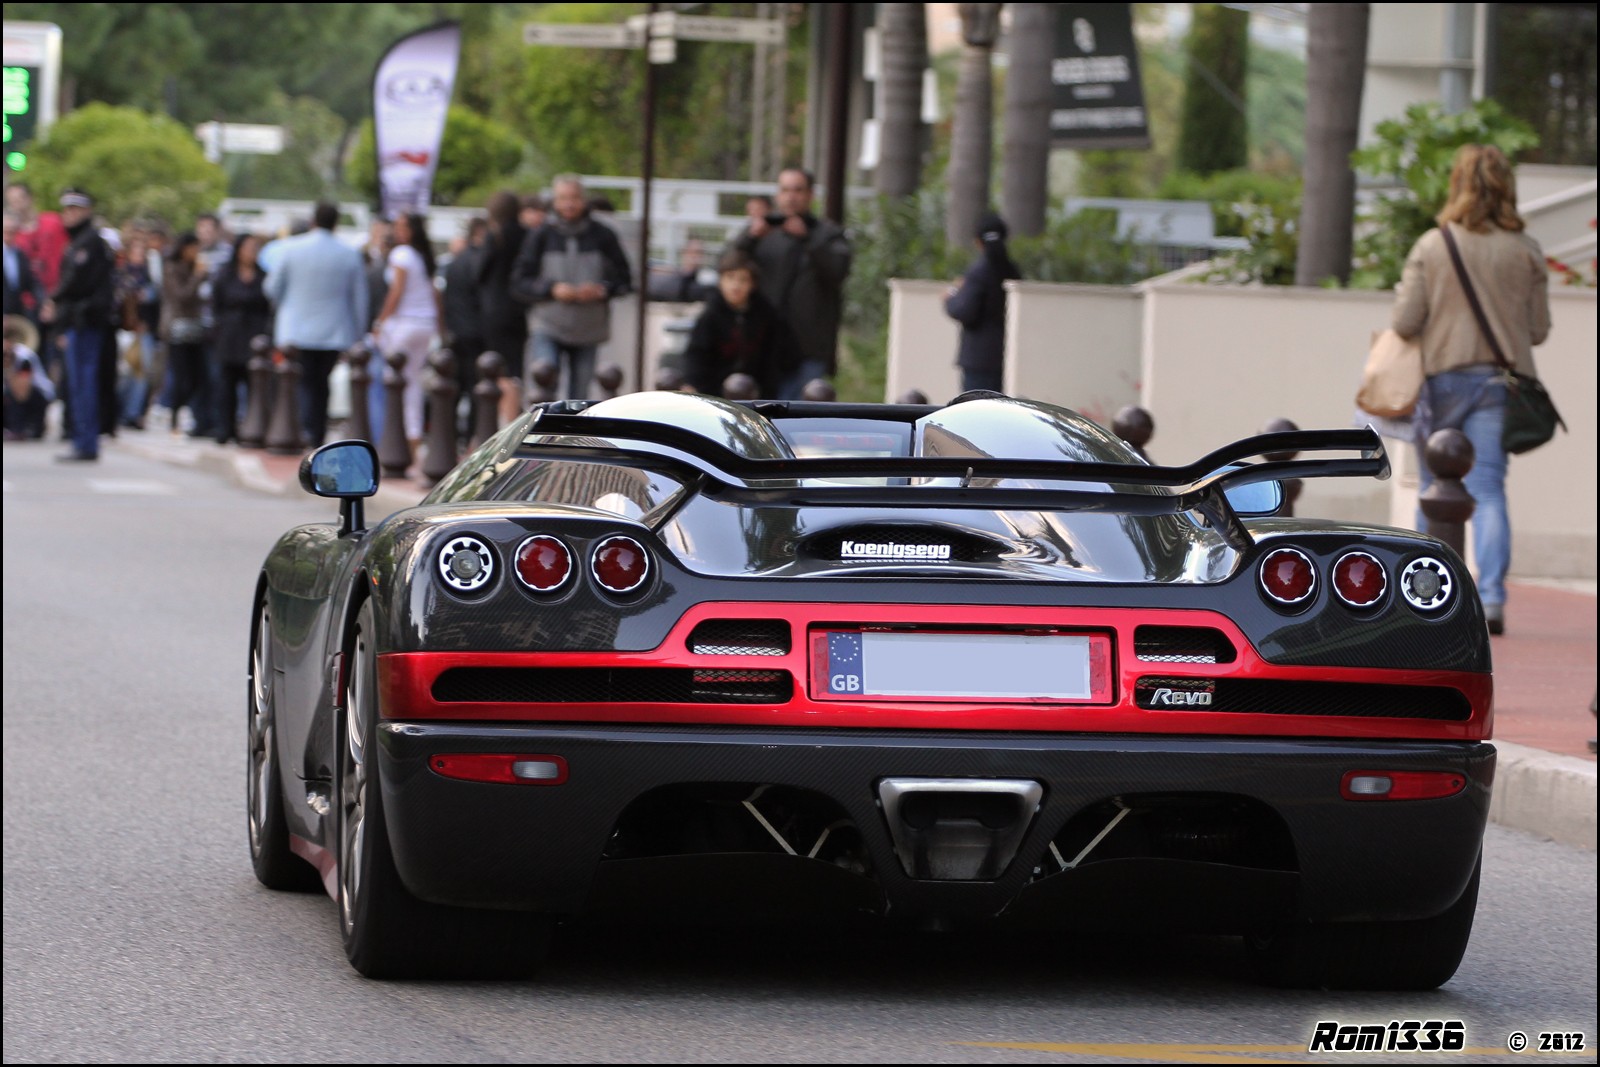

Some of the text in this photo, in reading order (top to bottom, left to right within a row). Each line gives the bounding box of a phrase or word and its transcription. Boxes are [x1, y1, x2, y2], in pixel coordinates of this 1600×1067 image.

[841, 541, 951, 559] Koenigsegg
[831, 674, 860, 692] GB
[1150, 688, 1212, 705] Revo
